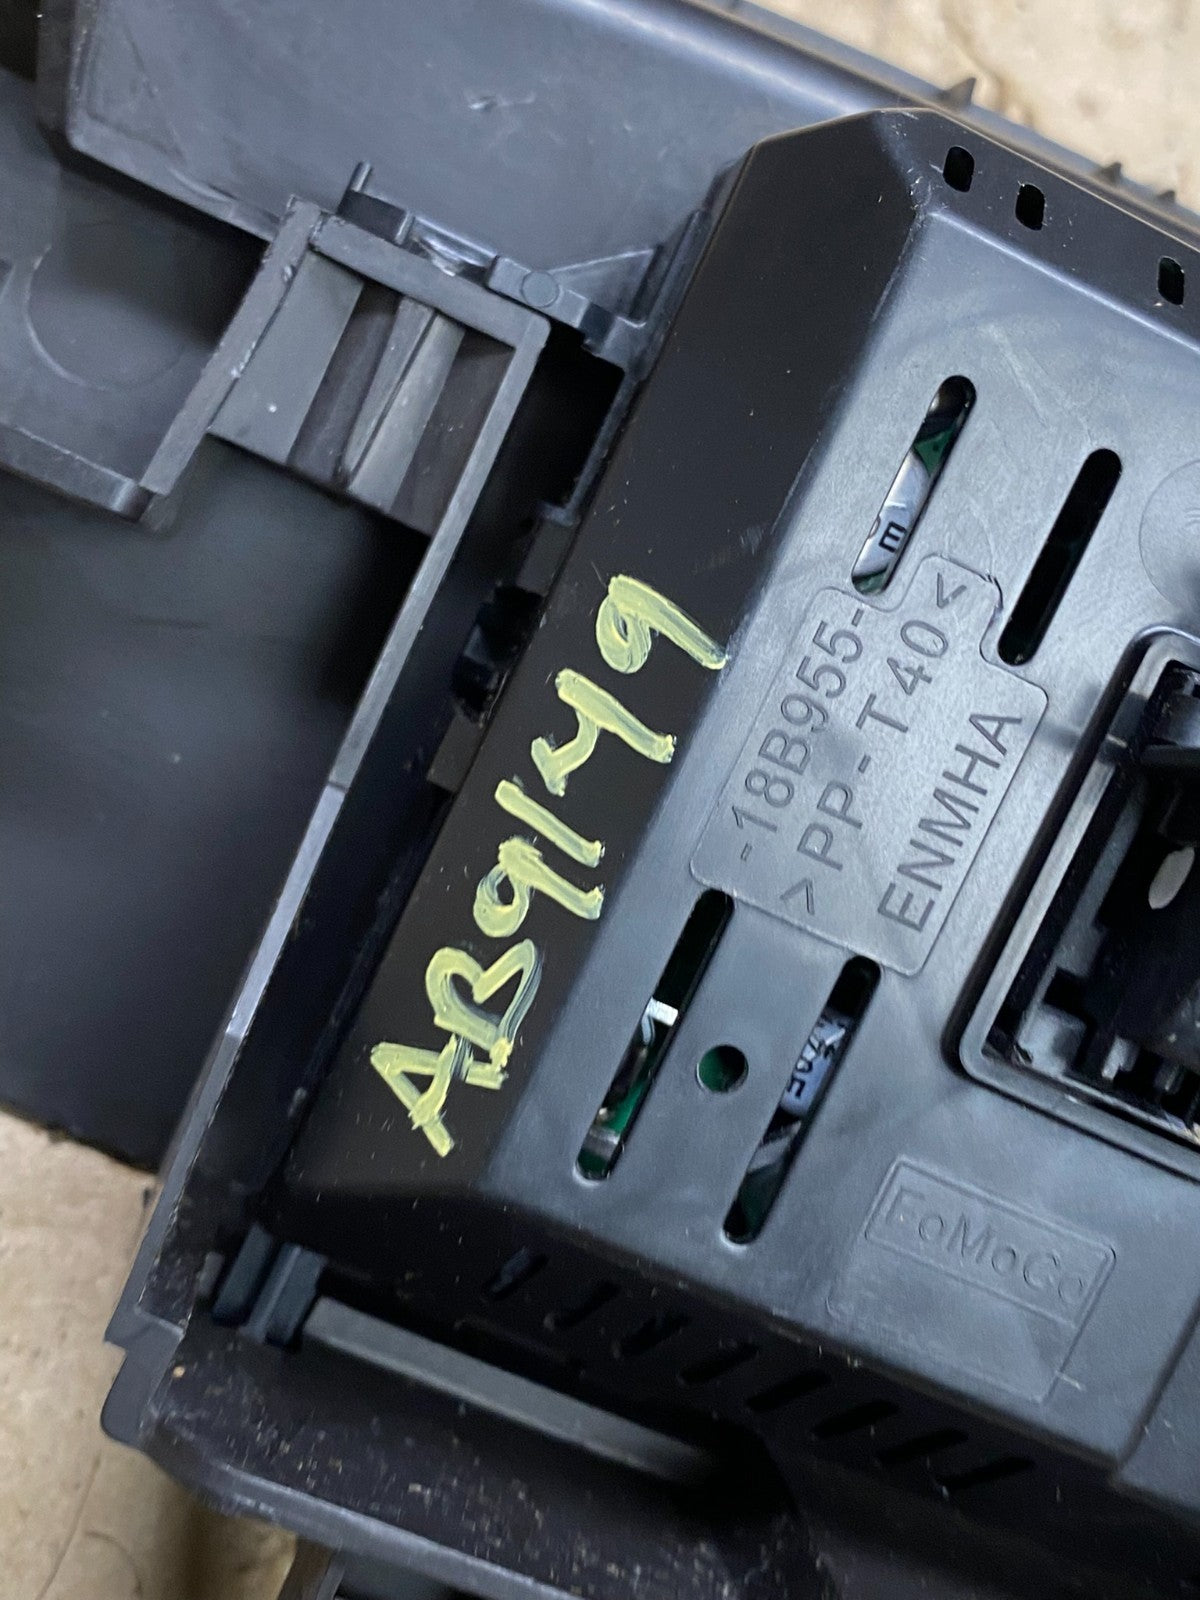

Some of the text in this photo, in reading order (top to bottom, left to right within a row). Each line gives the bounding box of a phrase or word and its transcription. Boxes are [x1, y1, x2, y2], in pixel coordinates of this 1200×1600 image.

[732, 608, 864, 861] -18B955-
[877, 711, 1023, 933] ENMHA
[370, 573, 728, 1156] AB9149
[886, 1188, 1085, 1304] FoMoCo
